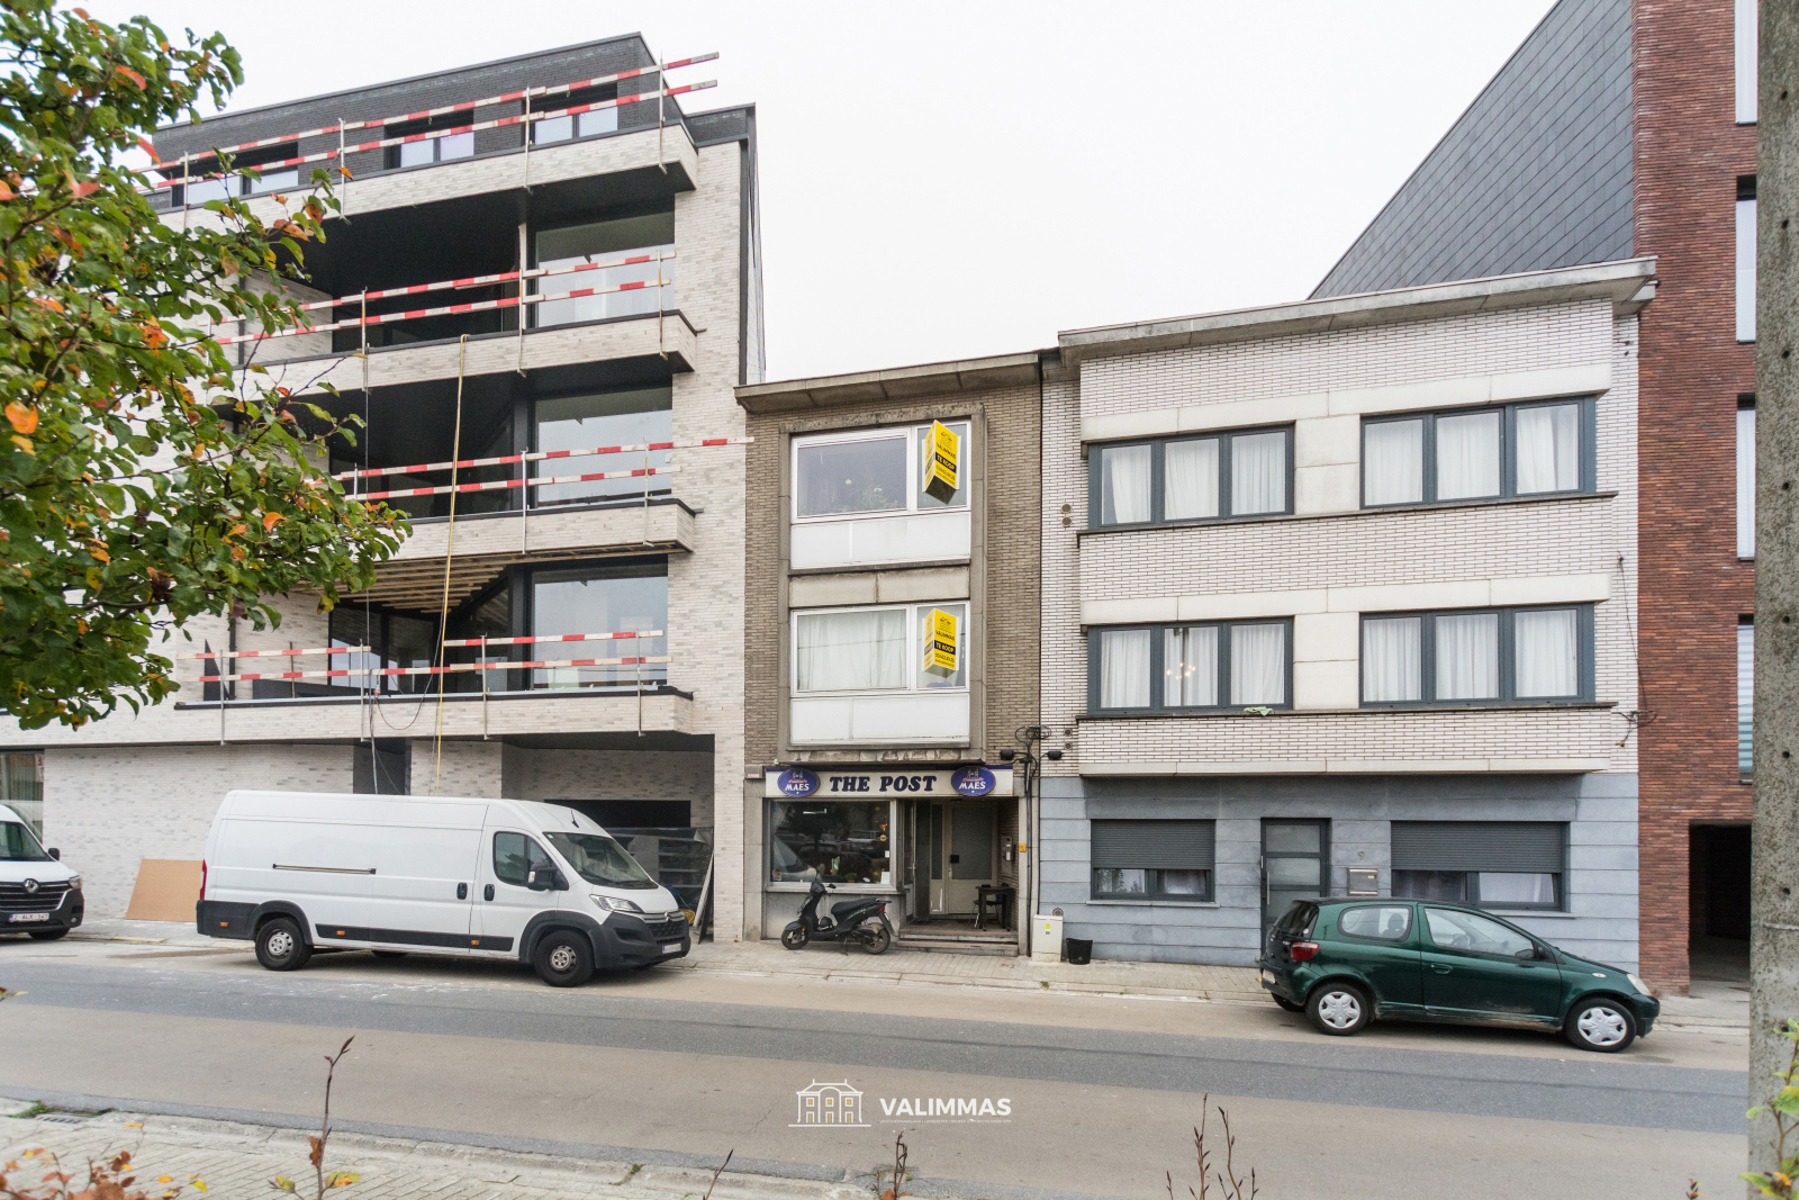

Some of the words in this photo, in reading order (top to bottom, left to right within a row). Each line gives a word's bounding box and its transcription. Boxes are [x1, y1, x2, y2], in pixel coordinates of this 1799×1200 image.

[784, 783, 810, 791] MAES
[829, 776, 870, 792] THE
[879, 775, 937, 792] POST
[958, 781, 986, 790] MAES
